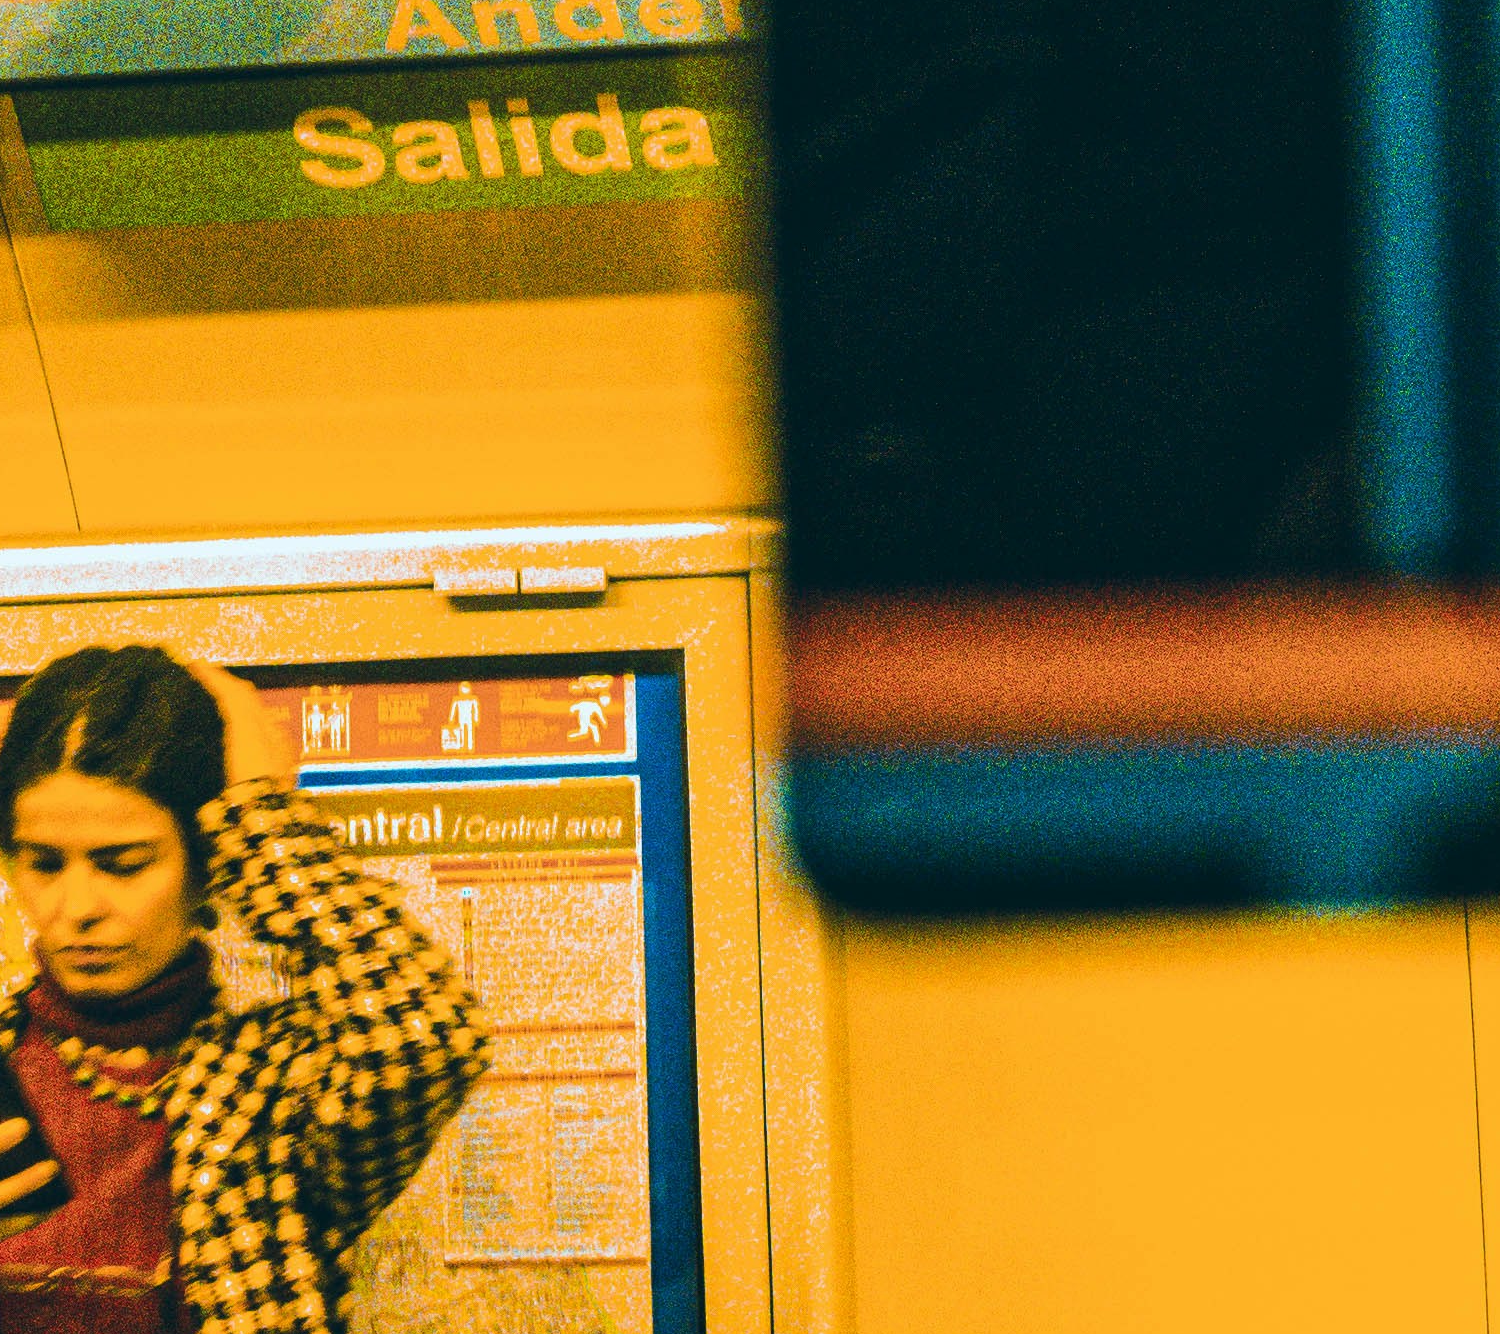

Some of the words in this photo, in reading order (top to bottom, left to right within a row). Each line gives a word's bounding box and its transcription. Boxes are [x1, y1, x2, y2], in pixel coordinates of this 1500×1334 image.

[293, 92, 718, 190] Salida
[465, 813, 559, 842] Central
[566, 815, 623, 840] area
